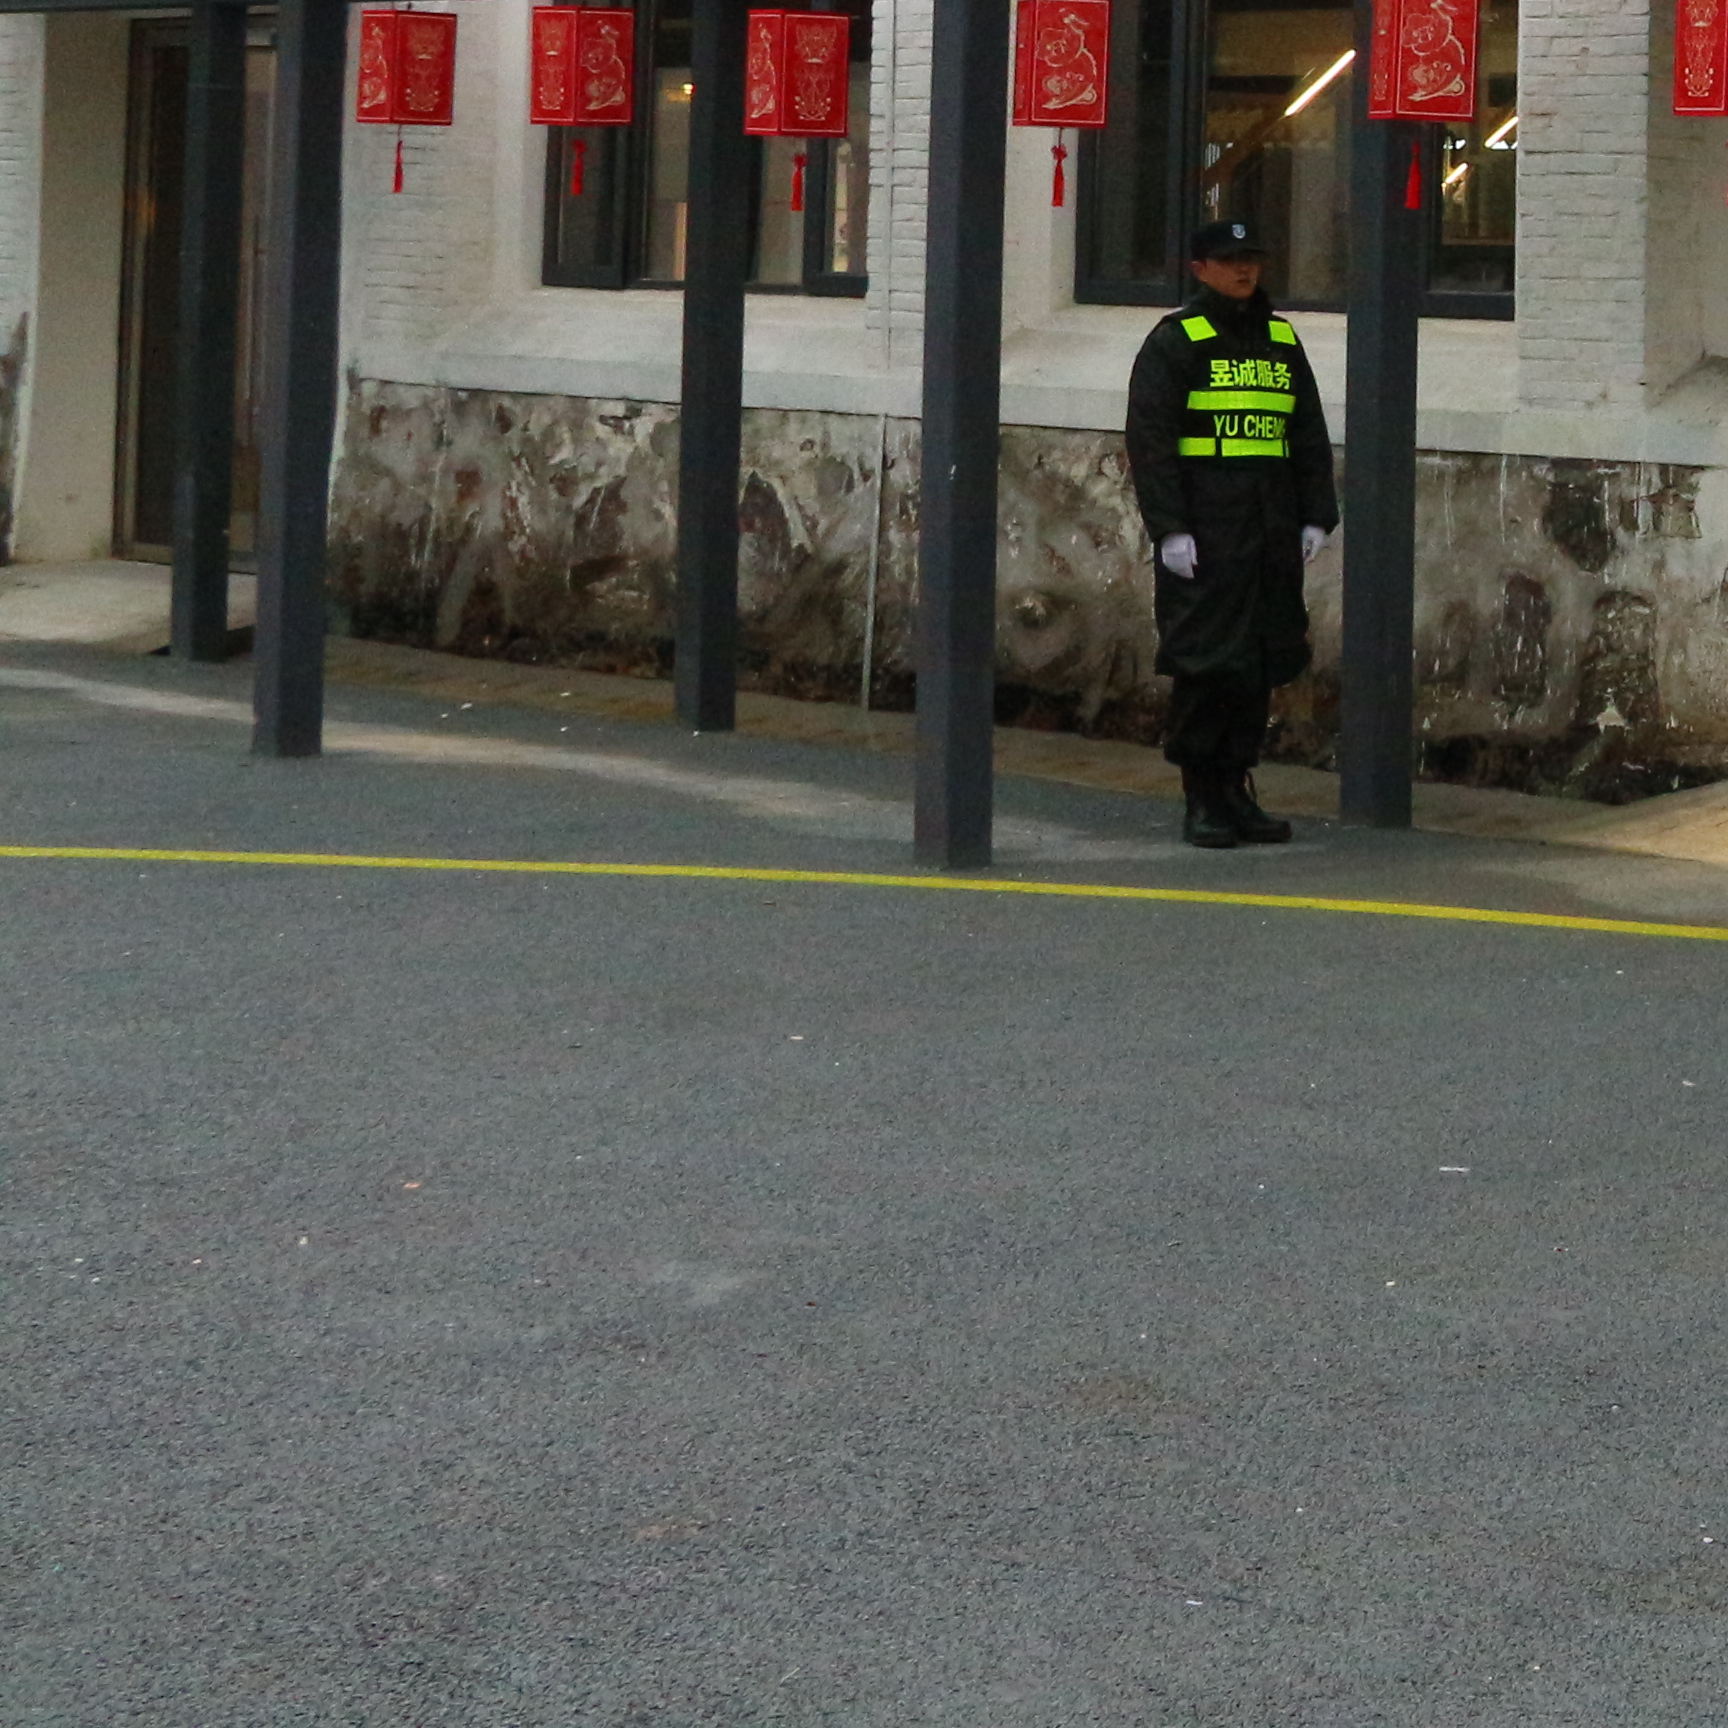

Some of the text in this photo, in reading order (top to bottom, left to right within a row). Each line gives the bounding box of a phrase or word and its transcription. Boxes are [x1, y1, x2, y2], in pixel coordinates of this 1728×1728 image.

[1210, 358, 1292, 390] 昱诚服务
[1213, 414, 1239, 437] YU
